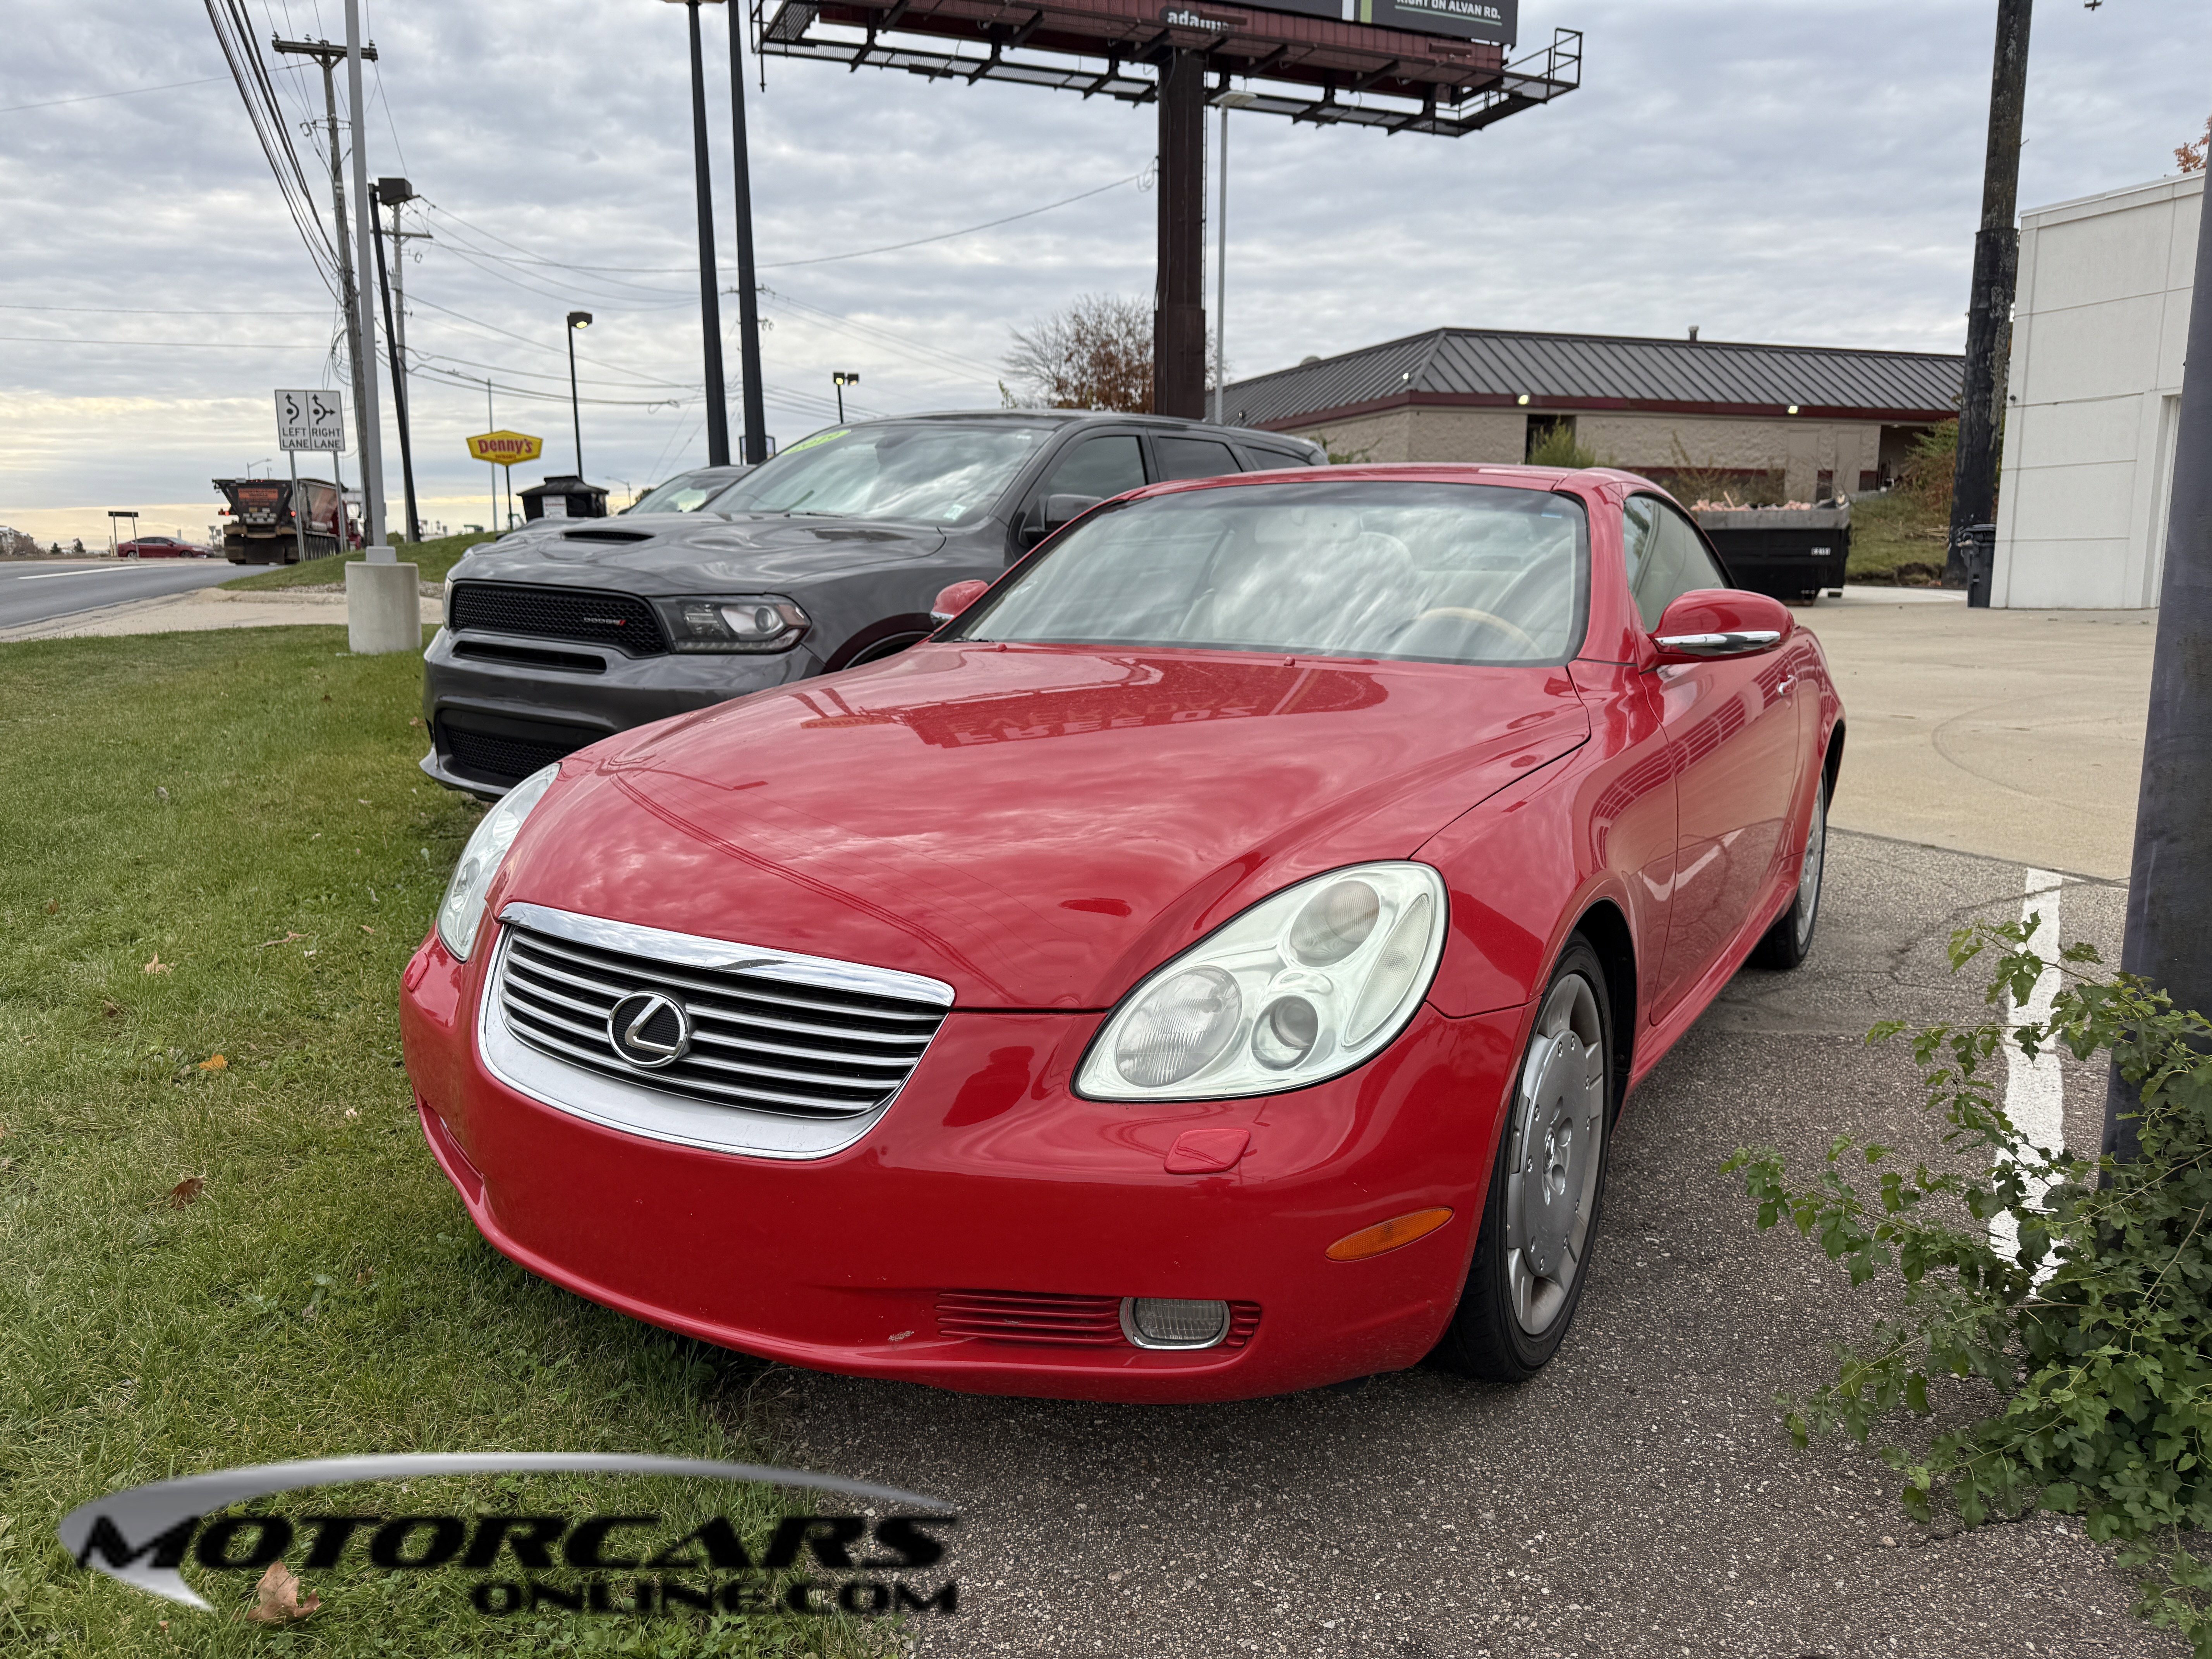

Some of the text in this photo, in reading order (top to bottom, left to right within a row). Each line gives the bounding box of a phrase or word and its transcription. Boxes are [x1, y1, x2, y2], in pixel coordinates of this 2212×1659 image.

[1431, 0, 1446, 10] ON
[1448, 0, 1482, 16] ALVAN
[1484, 6, 1501, 19] RD.
[282, 427, 307, 437] LEFT
[312, 427, 341, 437] RIGHT
[282, 438, 309, 448] LANE
[314, 439, 341, 449] LANE
[477, 438, 532, 454] Denny's
